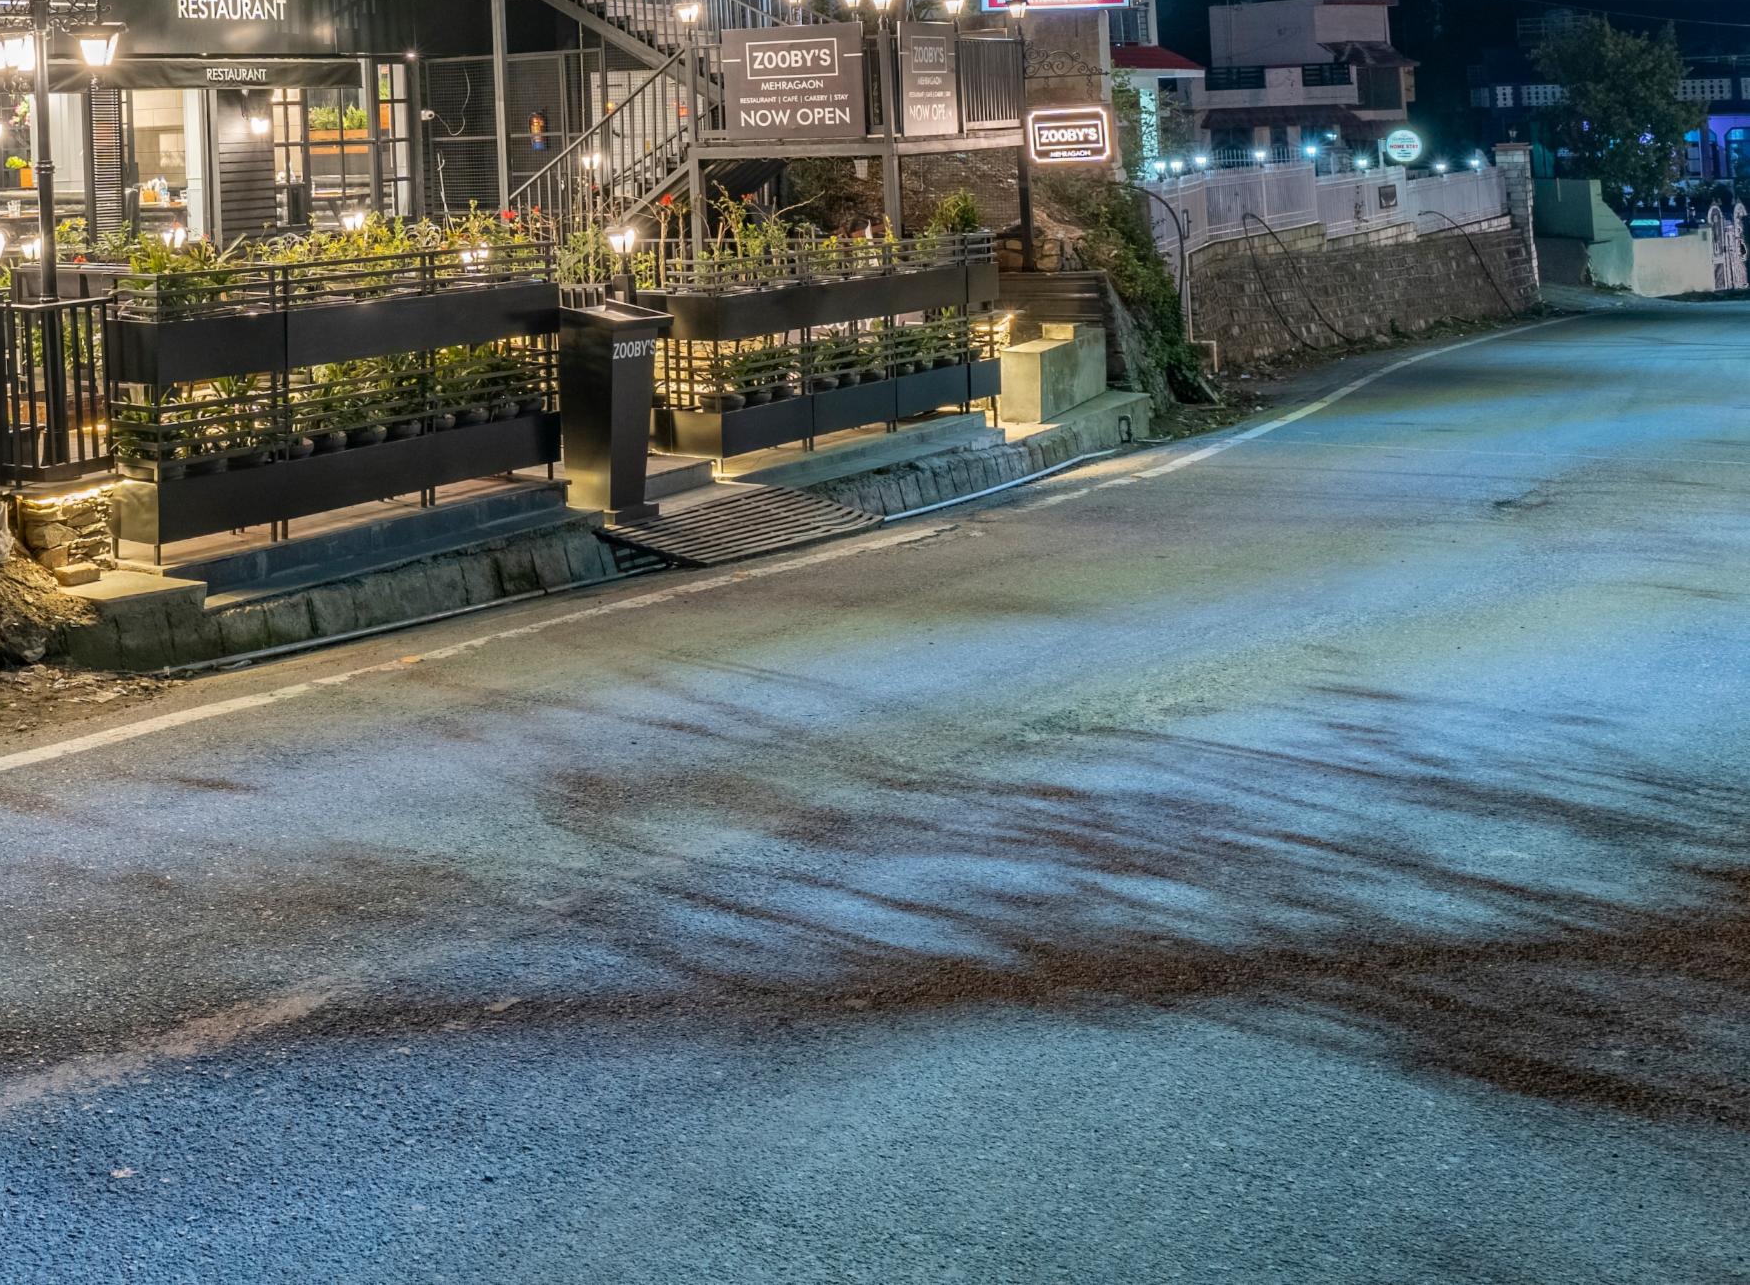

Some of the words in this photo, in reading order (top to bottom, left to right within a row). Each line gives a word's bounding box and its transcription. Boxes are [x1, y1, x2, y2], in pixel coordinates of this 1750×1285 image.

[752, 48, 831, 69] ZOOBY'S
[913, 46, 945, 63] ZOOBY'S
[206, 67, 267, 82] RESTAURANT
[761, 79, 824, 91] MEHRAGAON
[739, 96, 777, 104] RESTAURANT
[804, 94, 828, 102] CAKERY
[833, 93, 849, 101] STAY
[740, 109, 790, 127] NOW
[796, 106, 851, 125] OPEN
[909, 104, 930, 121] NOW
[1039, 127, 1098, 143] ZOOBY'S
[613, 339, 656, 360] ZOOBY'S
